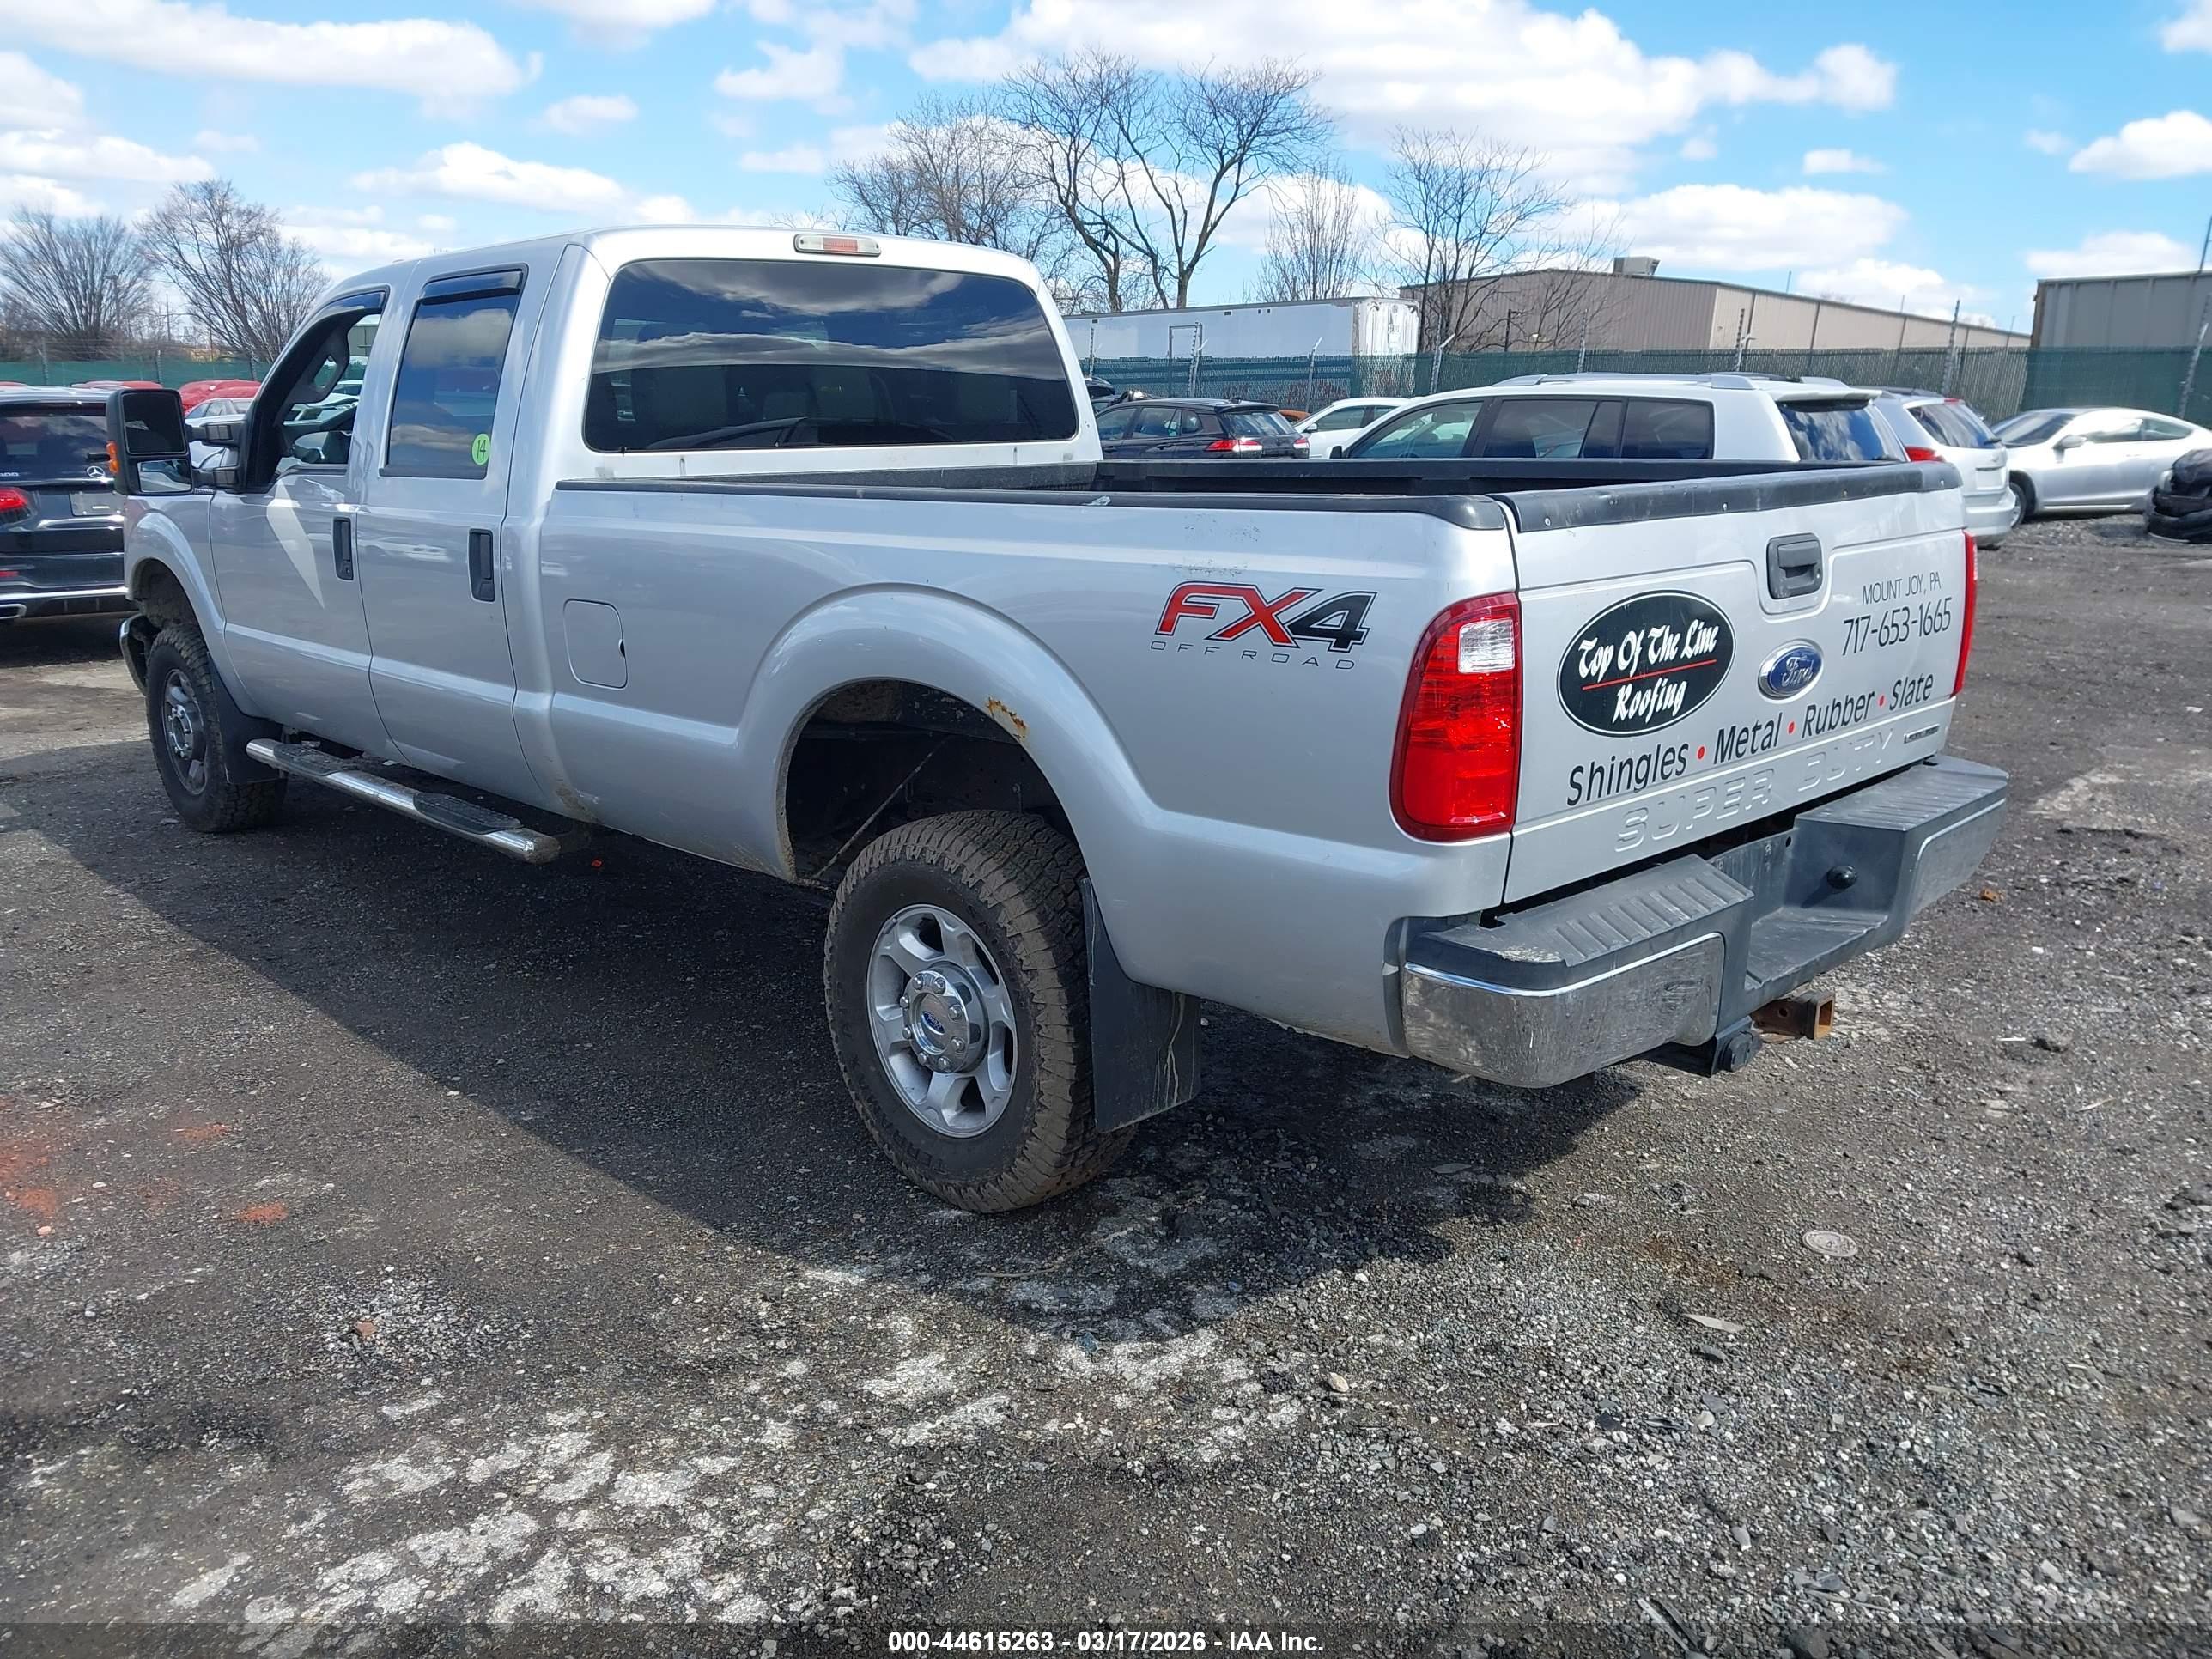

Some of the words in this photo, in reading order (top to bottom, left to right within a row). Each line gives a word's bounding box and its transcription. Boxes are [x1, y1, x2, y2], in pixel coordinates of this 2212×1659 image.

[477, 439, 486, 459] 14
[1863, 579, 1902, 605] MOUNT
[1905, 575, 1926, 596] JOY,
[1929, 572, 1941, 591] PA
[1154, 580, 1377, 653] FX4
[1843, 598, 1952, 655] 717-653-1665
[1150, 641, 1220, 655] OFF
[1241, 649, 1355, 670] ROAD
[1578, 637, 1614, 683] Top
[1617, 629, 1645, 678] Of
[1647, 624, 1680, 665] The
[1680, 619, 1719, 659] Line
[1781, 656, 1814, 686] Ford
[1612, 678, 1687, 724] Roofing
[1567, 744, 1688, 806] Shingles
[1714, 713, 1782, 764] Metal
[1802, 690, 1875, 738] Rubber
[1889, 673, 1934, 711] Slate
[1614, 768, 1775, 854] SUPER
[1798, 727, 1893, 792] DUTY
